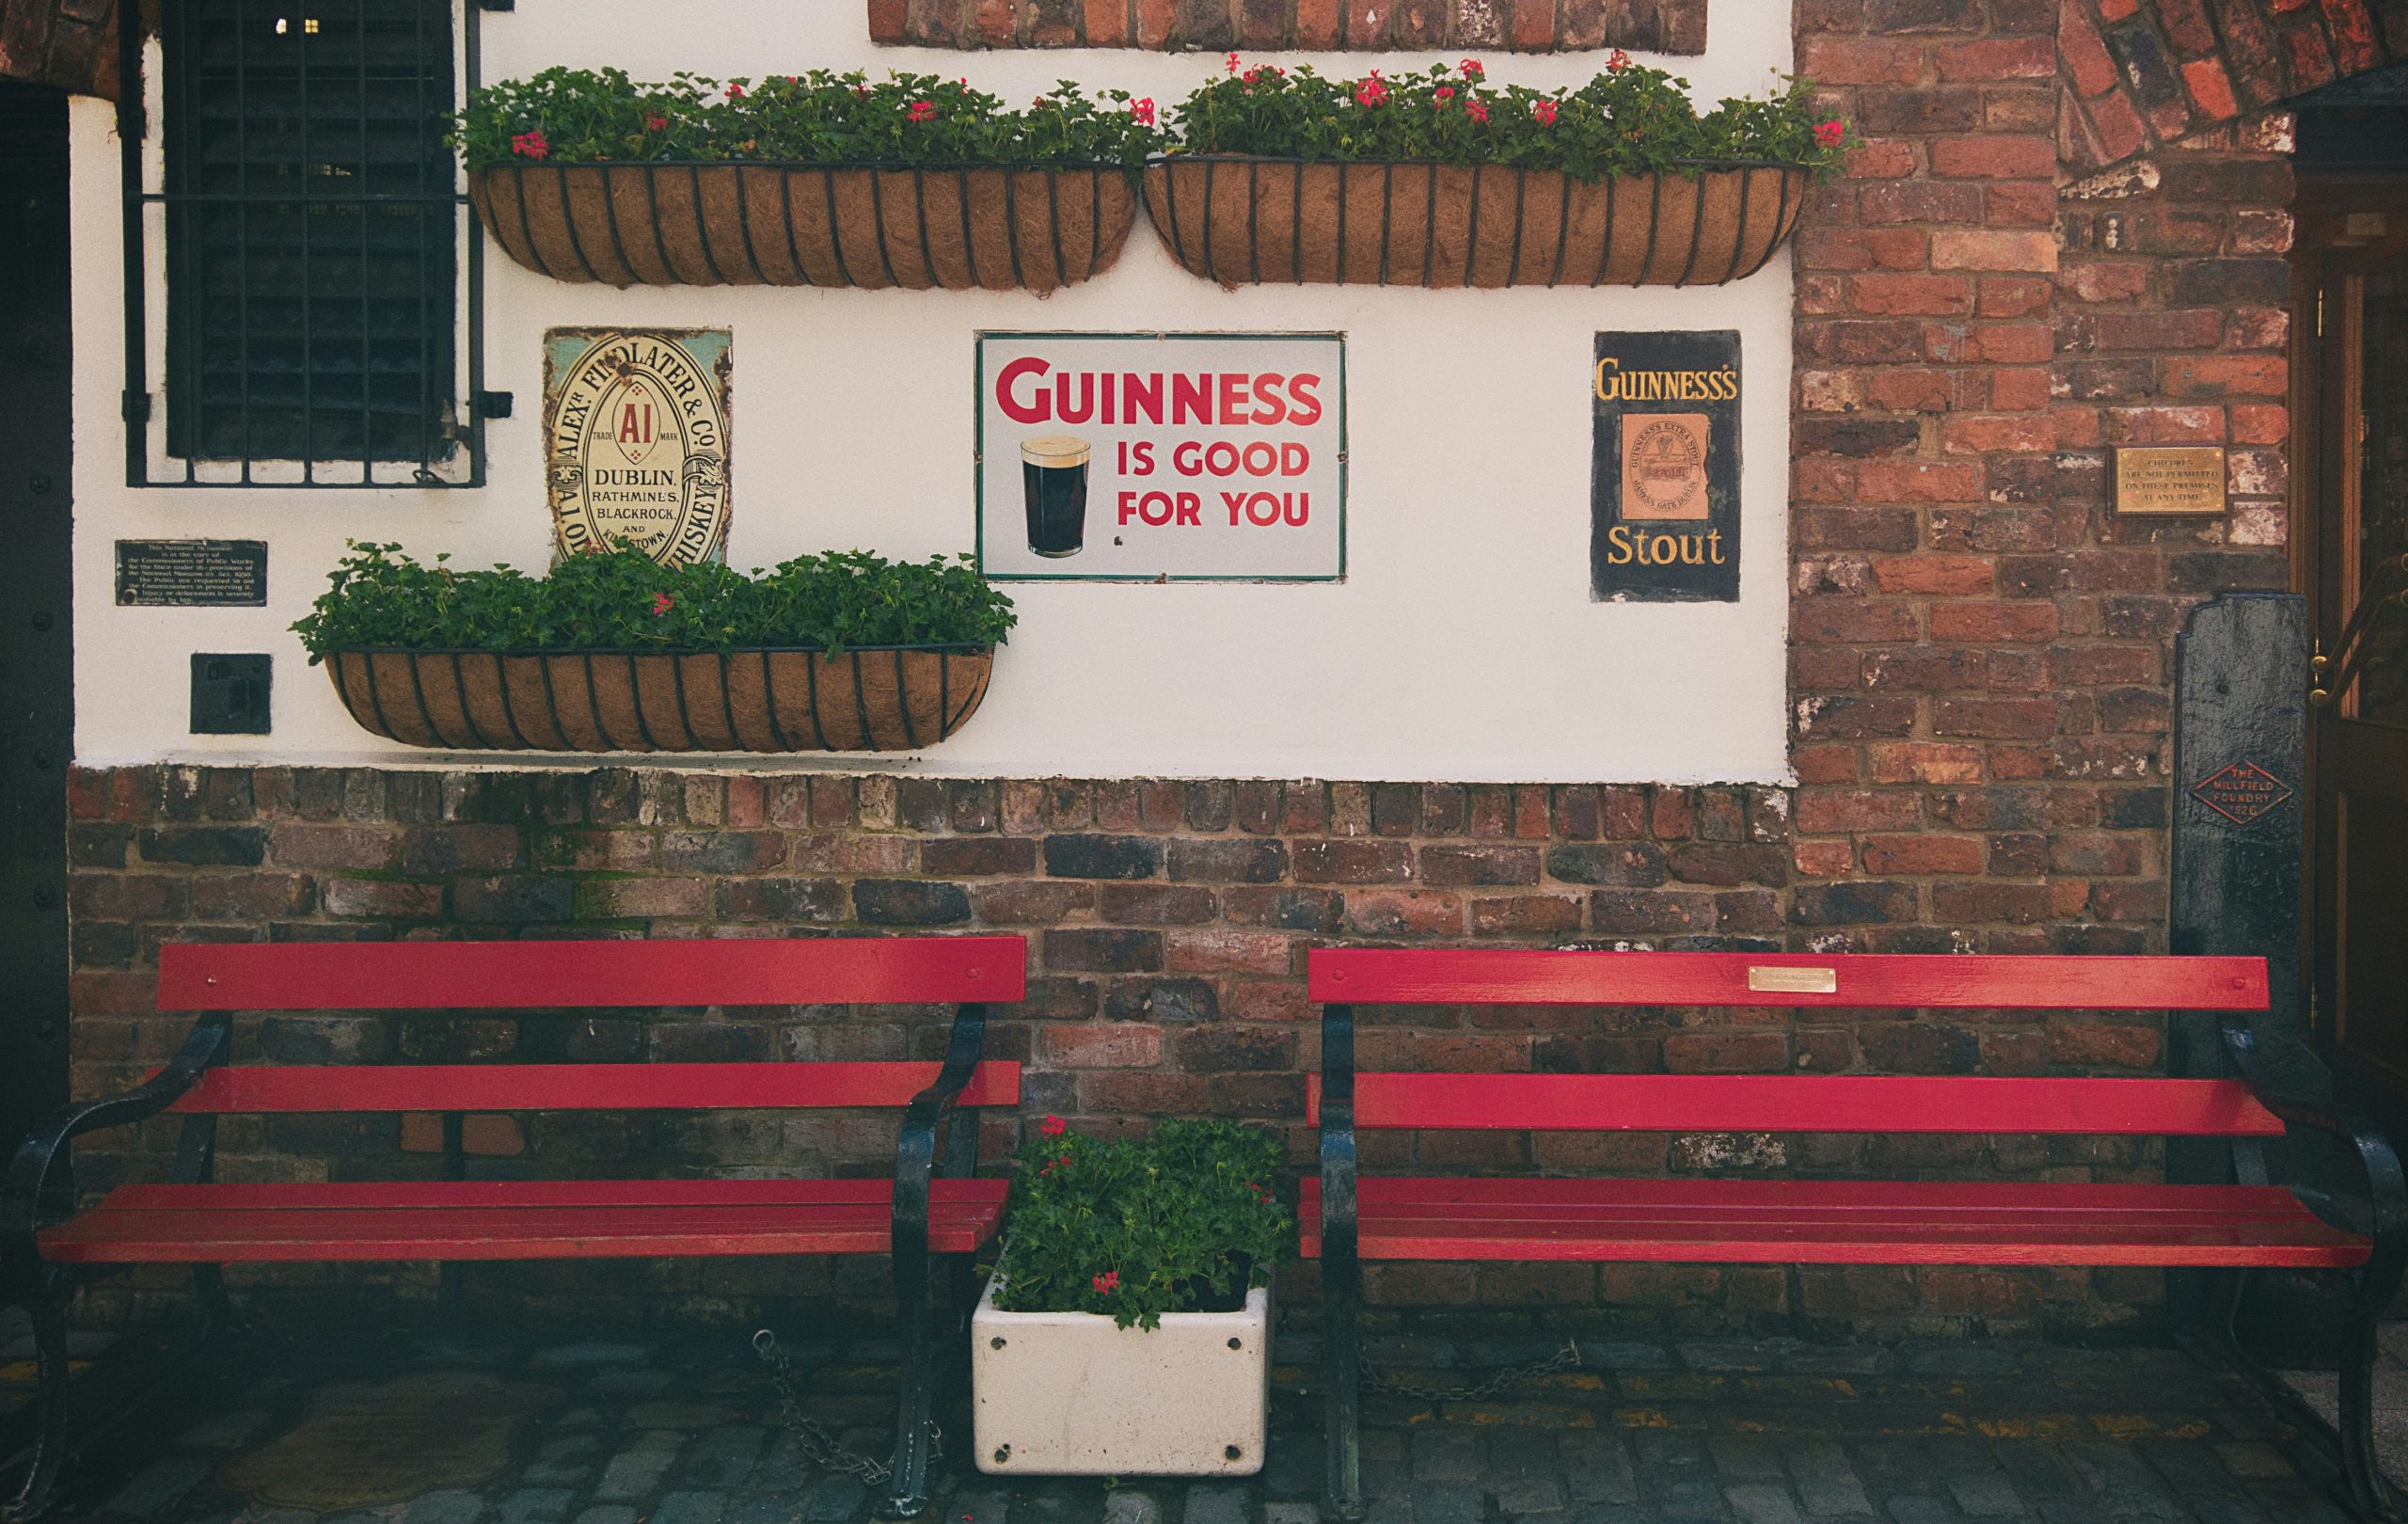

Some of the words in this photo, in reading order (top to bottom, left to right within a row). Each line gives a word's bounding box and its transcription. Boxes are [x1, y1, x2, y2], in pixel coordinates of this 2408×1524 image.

[996, 357, 1322, 425] GUINNESS
[683, 398, 703, 419] &
[593, 432, 612, 440] TRADE
[659, 433, 678, 441] MARK
[1664, 422, 1689, 440] EXTRA
[1688, 440, 1700, 468] STOUT
[1118, 441, 1154, 475] IS
[1173, 441, 1309, 476] GOOD
[595, 469, 676, 485] DUBLIN.
[593, 492, 679, 503] RATHMINES.
[1118, 491, 1201, 526] FOR
[1220, 492, 1309, 526] YOU
[1656, 501, 1677, 510] GATE
[597, 509, 677, 520] BLACKROCK.
[1608, 526, 1725, 564] Stout
[2231, 769, 2254, 778] THE
[2213, 781, 2273, 791] MILLFIELD
[2213, 794, 2270, 802] FOUNDRY
